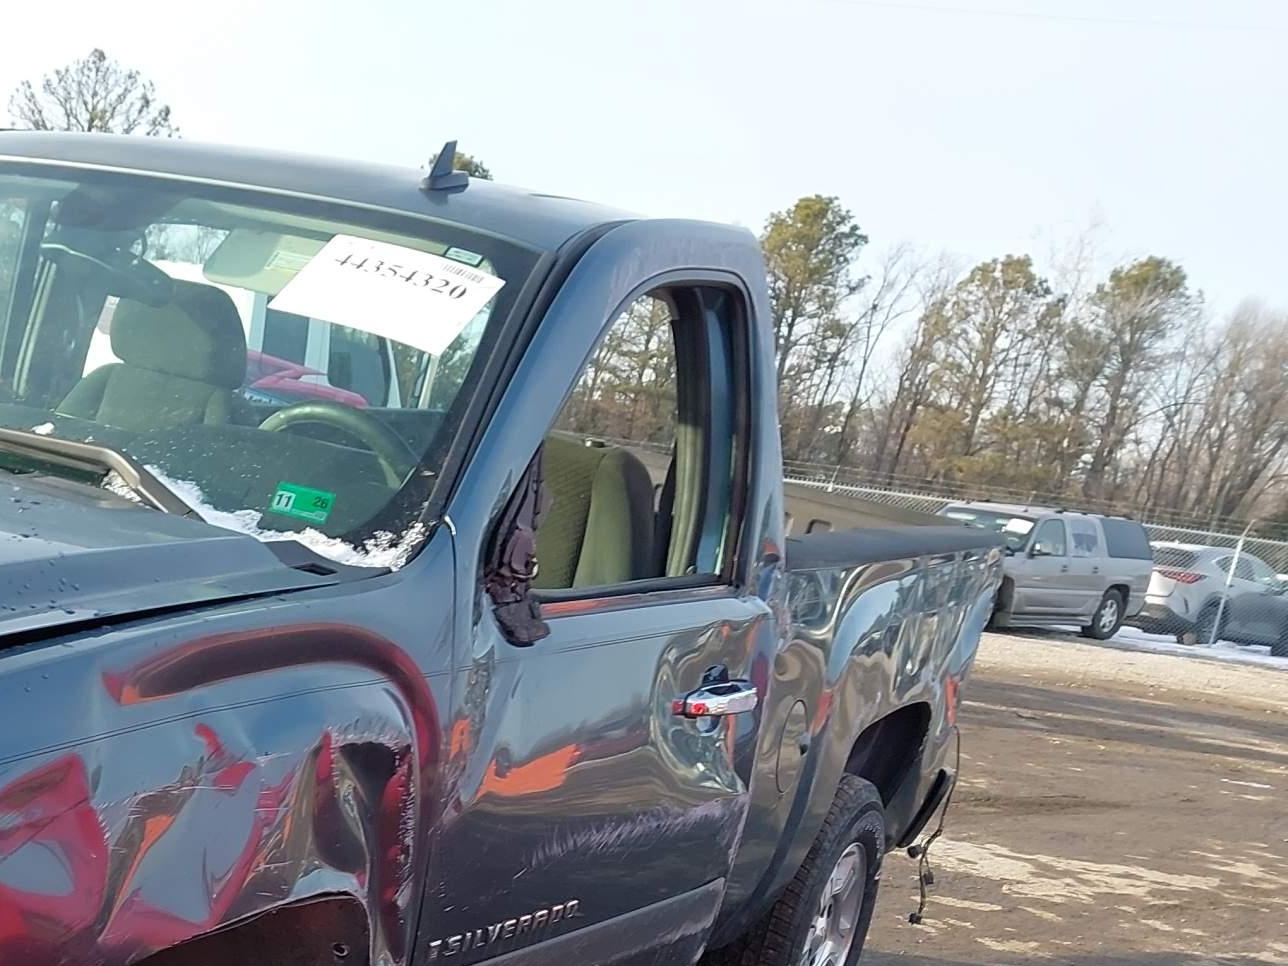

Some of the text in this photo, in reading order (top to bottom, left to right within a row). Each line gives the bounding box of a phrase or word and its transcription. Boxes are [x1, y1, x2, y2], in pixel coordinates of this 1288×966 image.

[335, 253, 468, 300] 44354320
[275, 493, 293, 508] 11
[442, 898, 584, 957] SILVERADO
